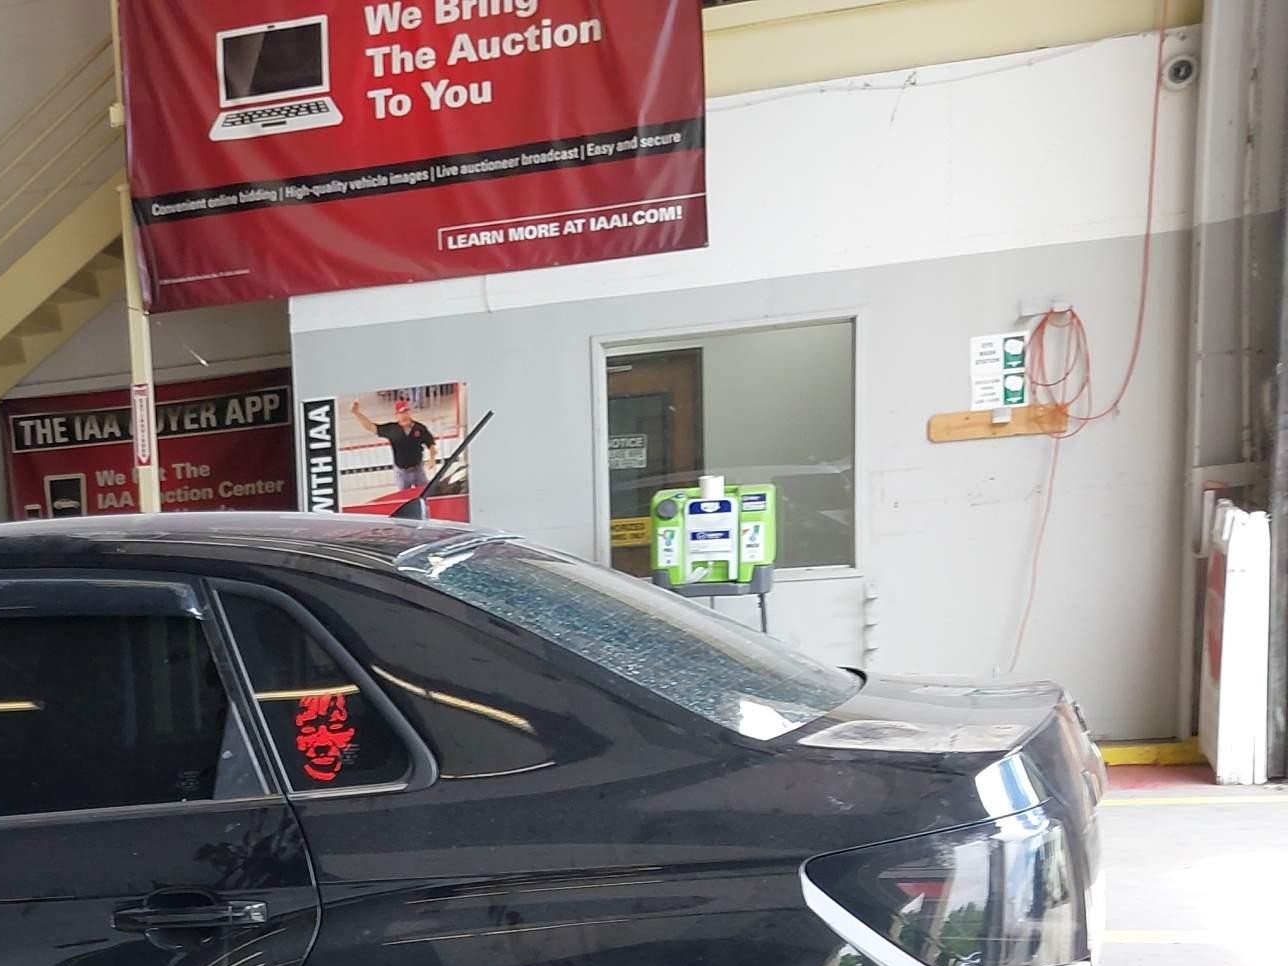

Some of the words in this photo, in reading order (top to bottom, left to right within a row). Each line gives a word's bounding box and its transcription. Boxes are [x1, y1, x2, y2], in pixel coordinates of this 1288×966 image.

[364, 2, 422, 35] We
[365, 44, 436, 77] The
[447, 18, 602, 65] Auction
[367, 88, 412, 119] To
[421, 79, 493, 111] You
[151, 198, 207, 217] Convenient
[208, 193, 238, 209] online
[239, 188, 277, 204] bidding
[285, 180, 348, 200] High-quality
[349, 175, 388, 190] vehicle
[390, 169, 429, 185] images
[436, 164, 458, 178] Live
[460, 157, 520, 175] auctioneer
[521, 147, 579, 166] broadcast
[586, 142, 615, 157] Easy
[616, 136, 637, 152] and
[640, 132, 681, 148] secure
[447, 229, 504, 250] LEARN
[508, 222, 560, 242] MORE
[563, 218, 586, 235] AT
[590, 205, 683, 232] IAAI.COM!
[20, 416, 69, 446] THE
[74, 414, 121, 441] IAA
[224, 393, 280, 425] APP
[308, 405, 332, 450] IAA
[96, 470, 126, 487] We
[172, 463, 210, 479] The
[97, 491, 134, 510] IAA
[218, 480, 286, 499] Center
